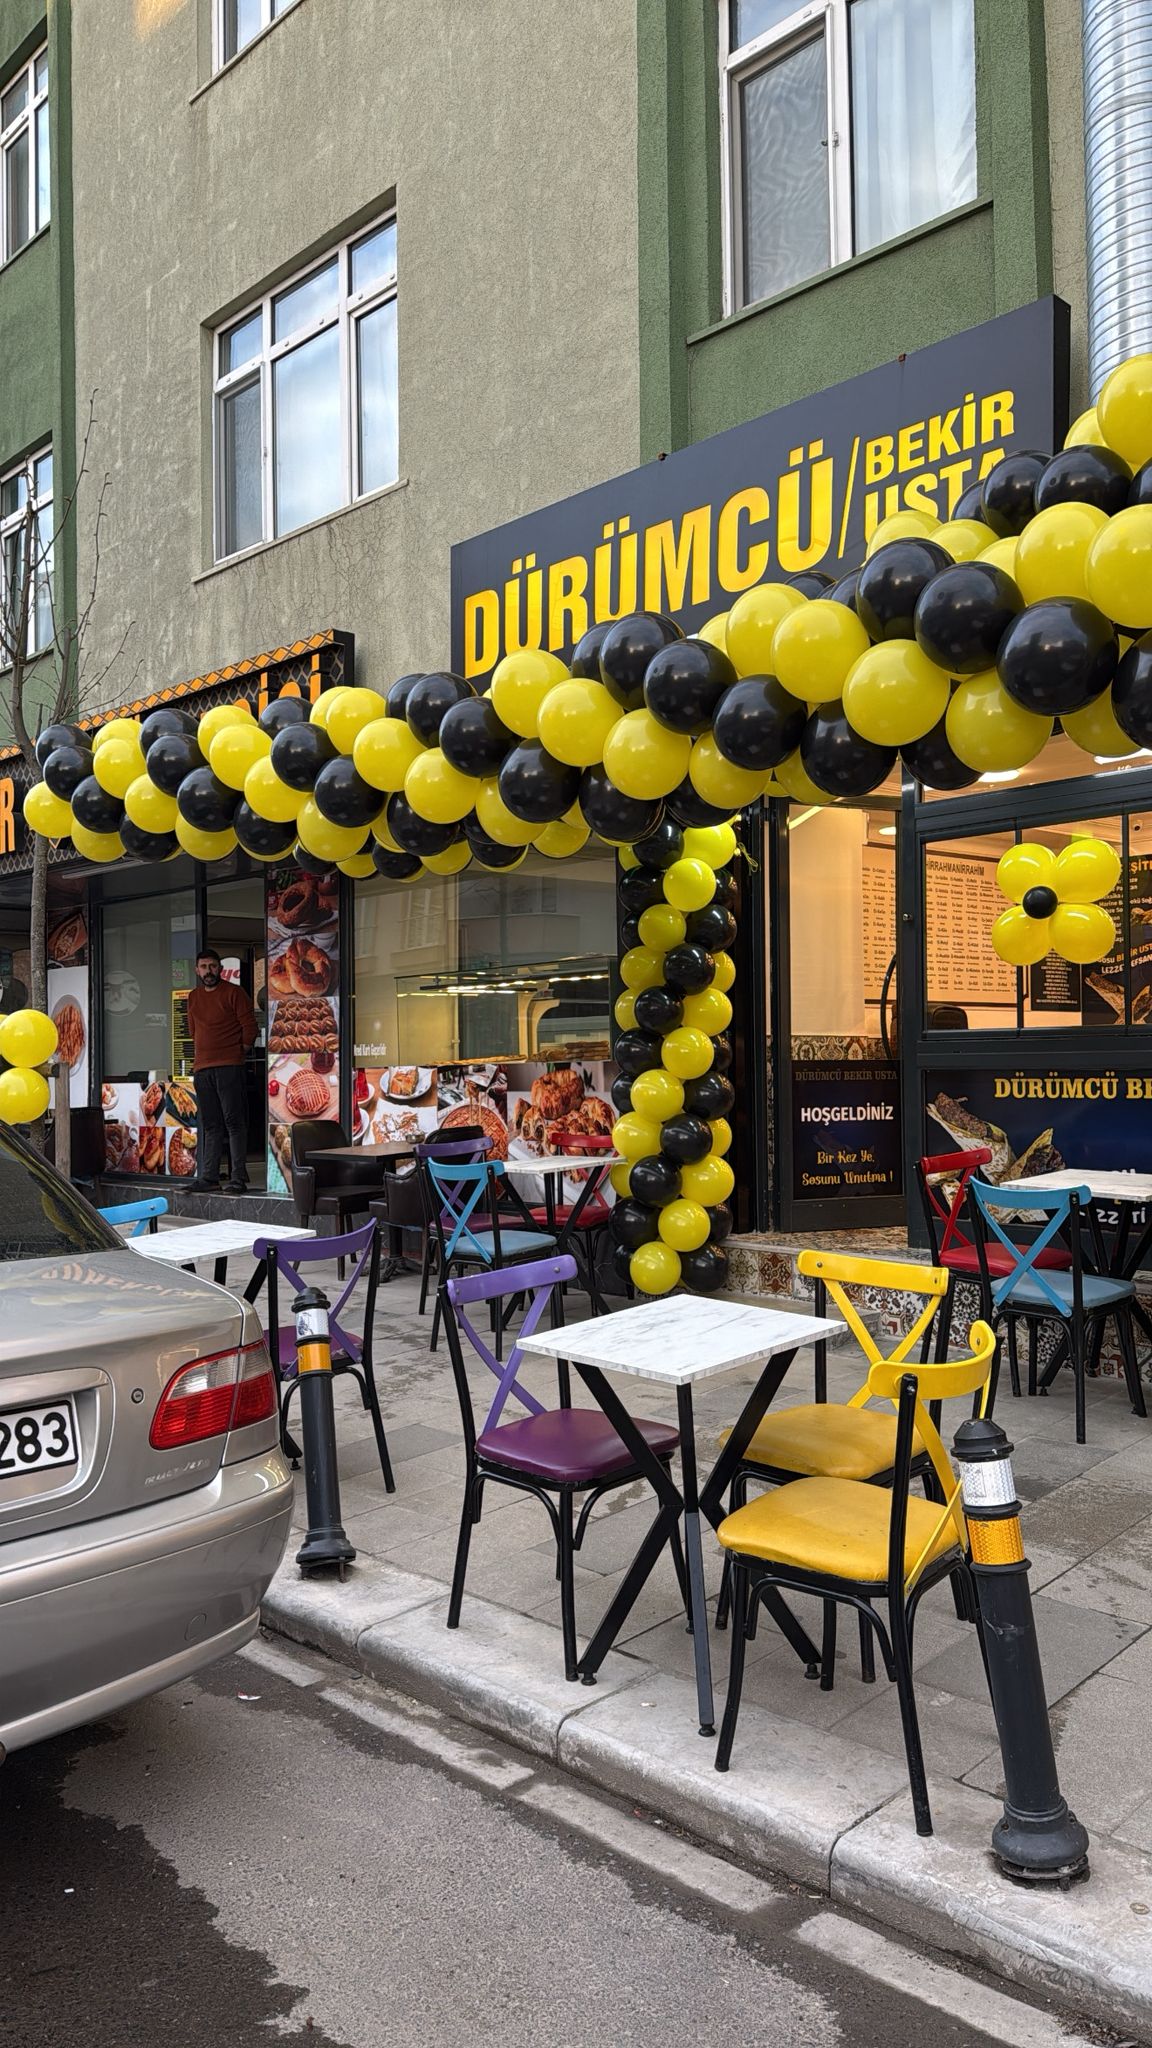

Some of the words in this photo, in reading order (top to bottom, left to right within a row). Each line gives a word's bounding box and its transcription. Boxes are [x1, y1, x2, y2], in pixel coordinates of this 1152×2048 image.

[865, 390, 1014, 486] BEKİR
[464, 439, 834, 680] DÜRÜMCÜ
[926, 858, 985, 877] İRRAHMANİRRAHİM
[795, 1068, 842, 1081] DÜRÜMCÜ
[844, 1068, 873, 1081] BEKİR
[874, 1070, 897, 1080] USTA
[994, 1071, 1119, 1099] DÜRÜMCÜ
[800, 1101, 894, 1126] HOŞGELDİNİZ
[816, 1151, 834, 1164] Bir
[837, 1150, 857, 1163] Kez
[802, 1172, 841, 1186] Sosunu
[843, 1170, 886, 1184] Unutma
[0, 1411, 69, 1469] 283
